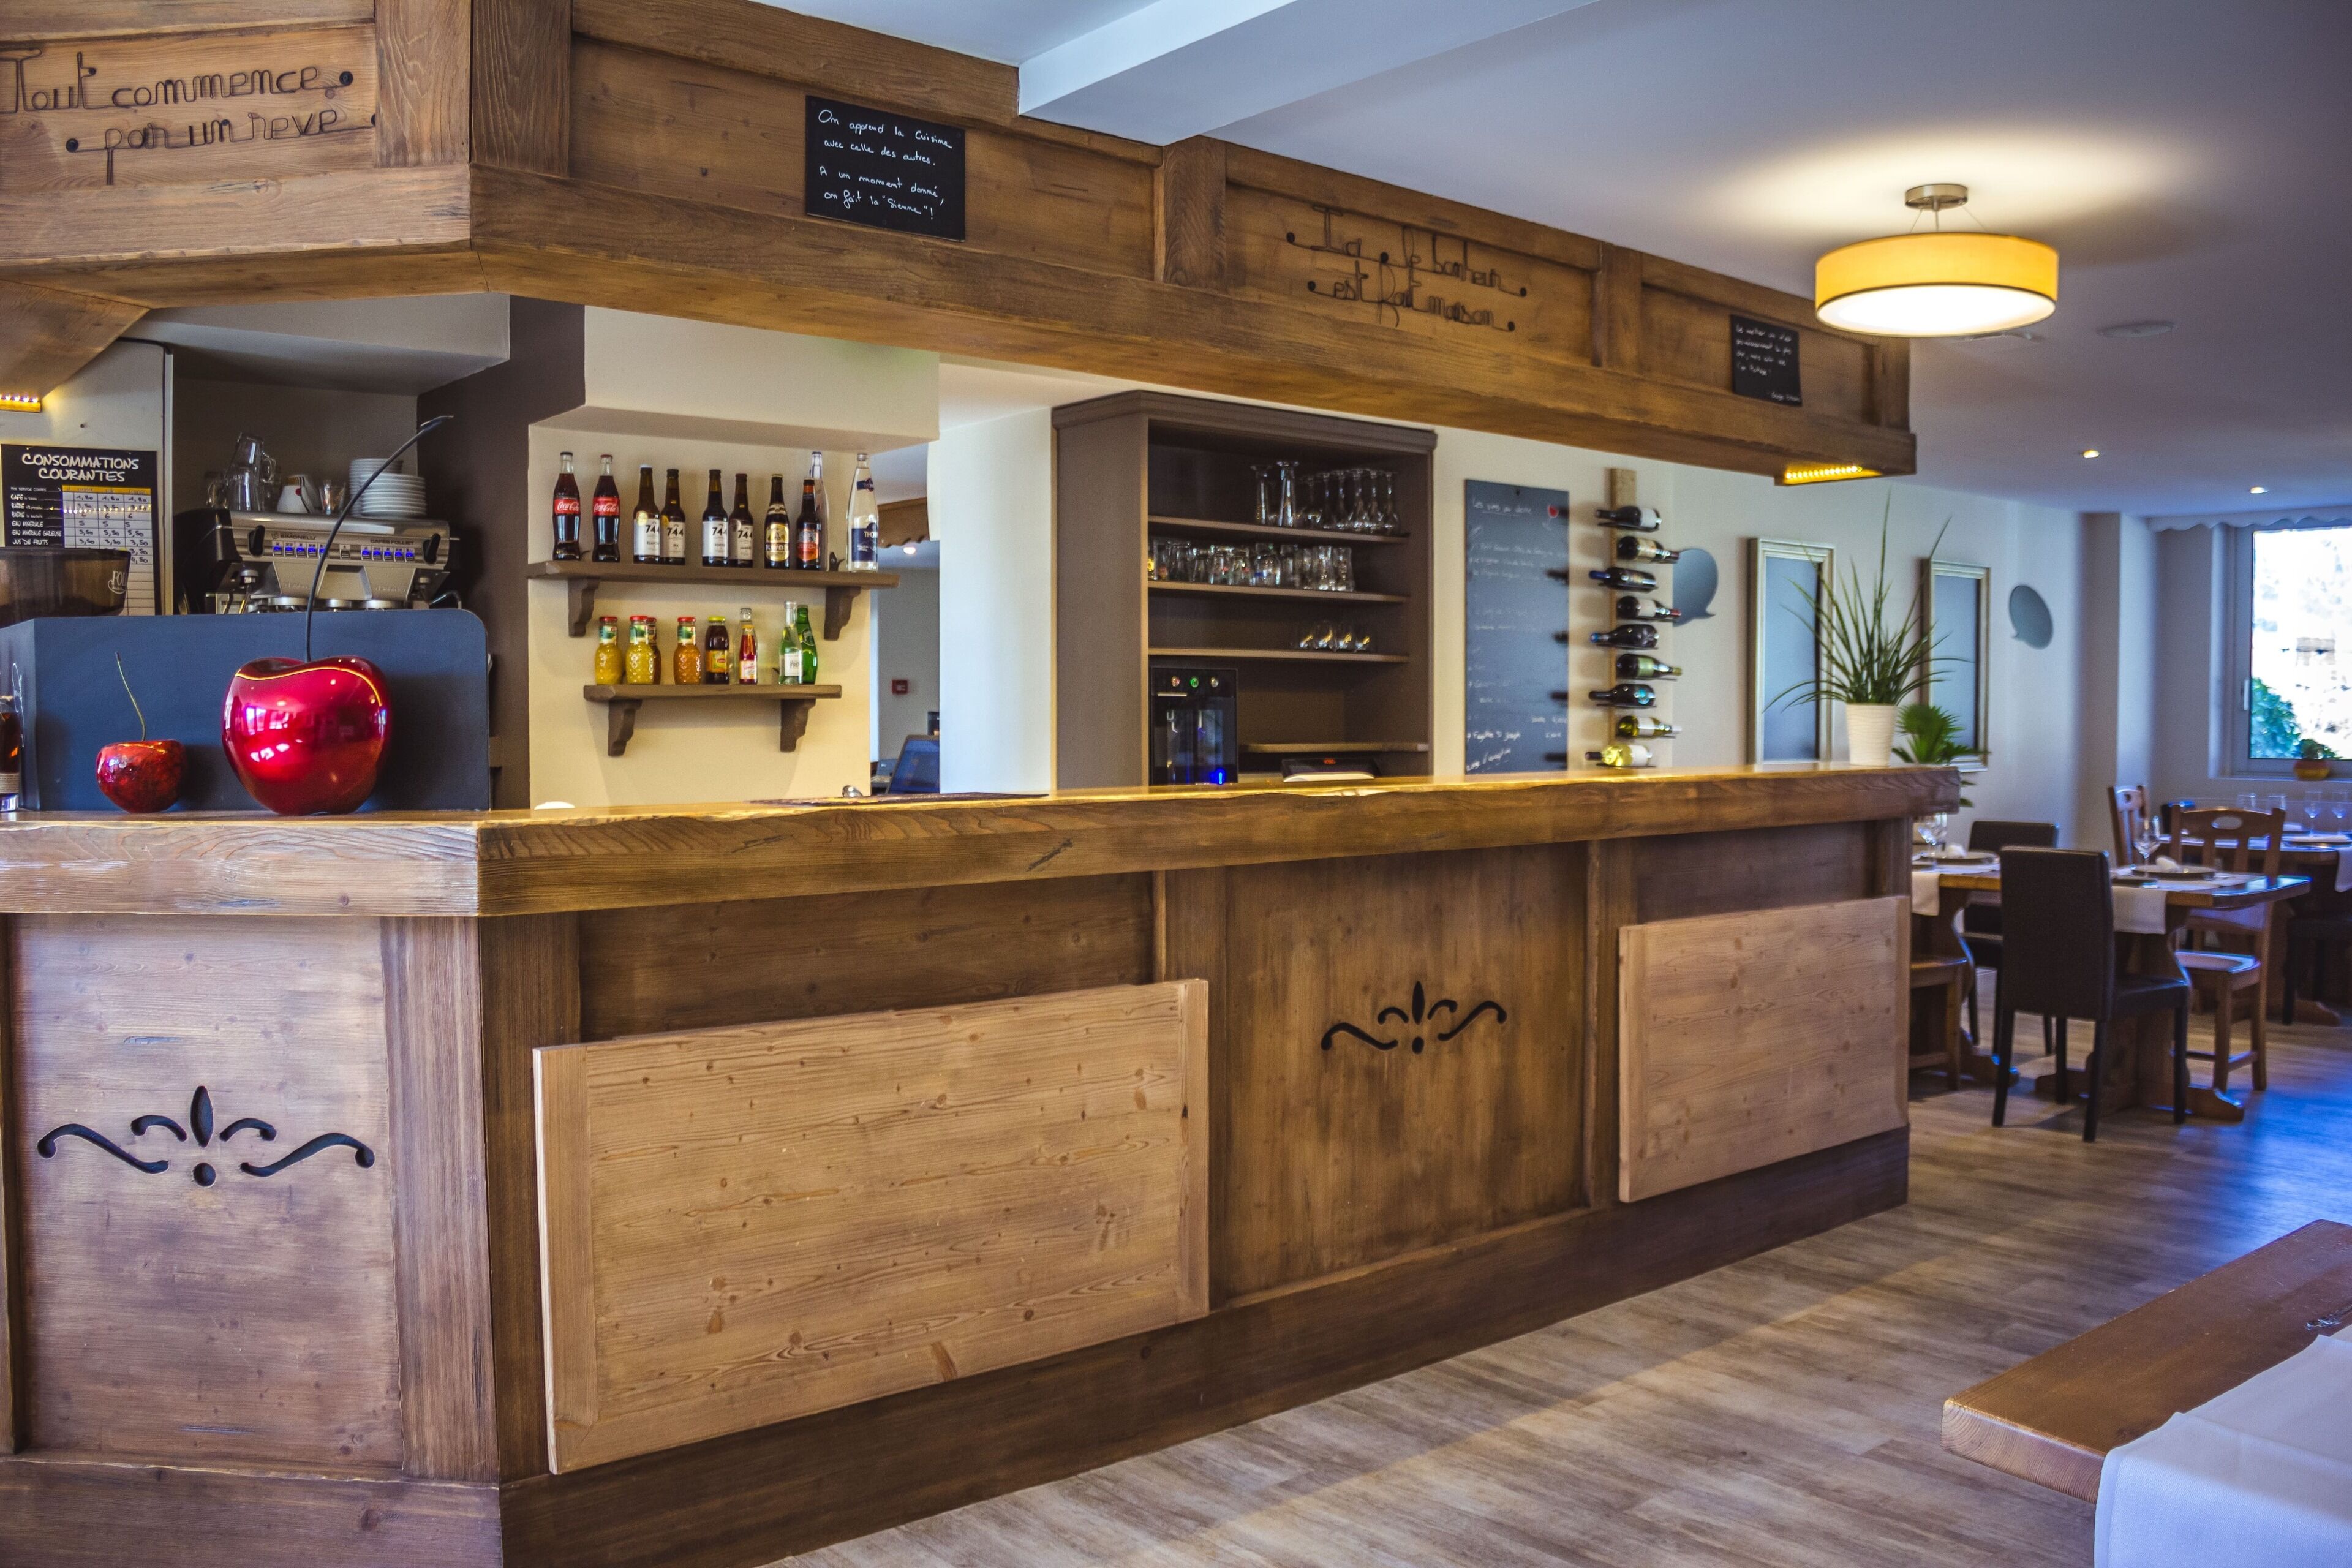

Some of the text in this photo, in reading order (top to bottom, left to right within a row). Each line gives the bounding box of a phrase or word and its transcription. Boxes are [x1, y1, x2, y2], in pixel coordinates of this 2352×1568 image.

[0, 48, 318, 114] Tout commence
[818, 110, 952, 149] On apprend la Cuisine
[105, 122, 168, 186] par
[189, 118, 232, 146] un
[824, 140, 843, 148] avec
[850, 143, 875, 153] celle
[881, 146, 896, 158] des
[820, 166, 827, 176] A
[859, 177, 903, 189] moment
[843, 189, 862, 209] fait
[870, 195, 879, 206] la
[21, 453, 140, 470] CONSOMMATIONS
[38, 467, 126, 482] COURANTES
